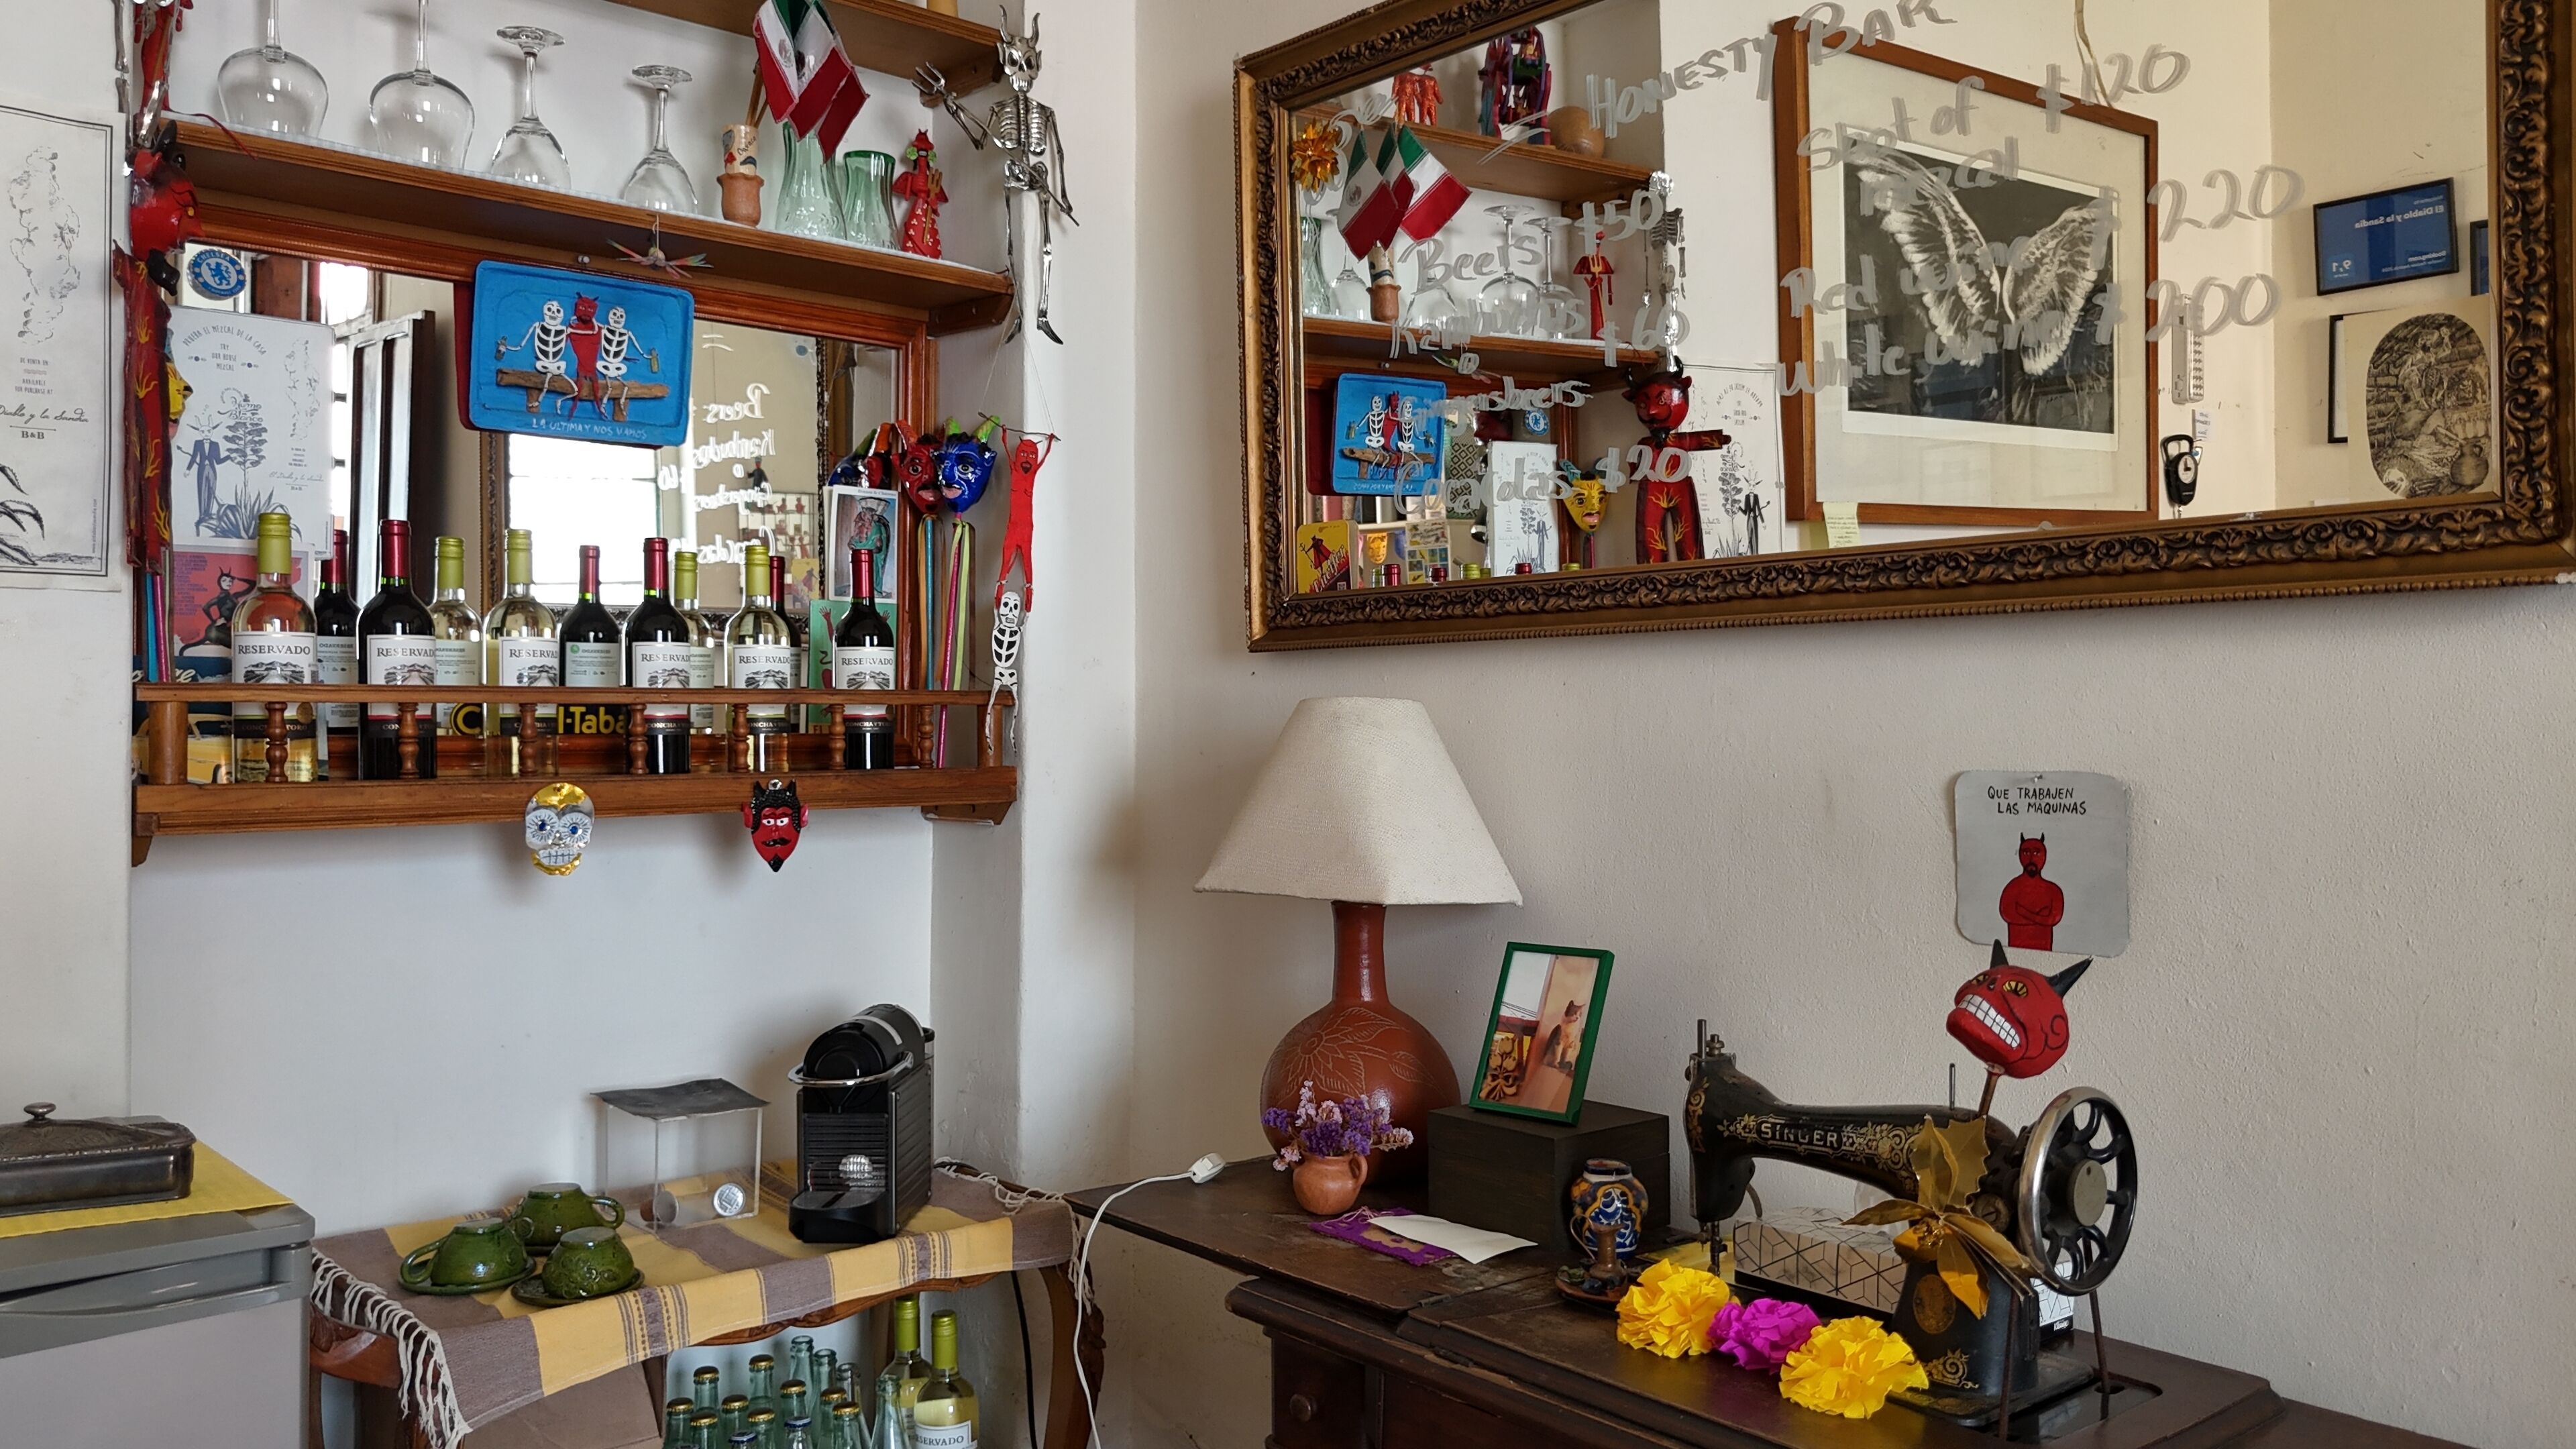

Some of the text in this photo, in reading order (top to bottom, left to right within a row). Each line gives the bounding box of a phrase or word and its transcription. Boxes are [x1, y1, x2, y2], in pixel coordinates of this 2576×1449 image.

[1931, 76, 1984, 136] of
[197, 252, 230, 262] CHELSEA
[1397, 235, 1544, 294] Beers
[1780, 254, 1878, 319] Red
[245, 334, 253, 342] LA
[24, 414, 36, 424] y
[40, 408, 50, 419] la
[21, 431, 44, 439] B&B
[533, 418, 545, 429] LA
[549, 422, 582, 432] ULTIMA
[594, 426, 613, 435] NOS
[616, 427, 647, 439] VAMOS
[238, 644, 311, 655] RESERVADO
[377, 647, 435, 657] RESERVAD
[841, 657, 893, 665] RESERVADO
[1988, 786, 2074, 800] QUE TRABAJEN
[1998, 801, 2086, 815] LAS MAQUINAS
[1761, 1123, 1837, 1148] SINGER
